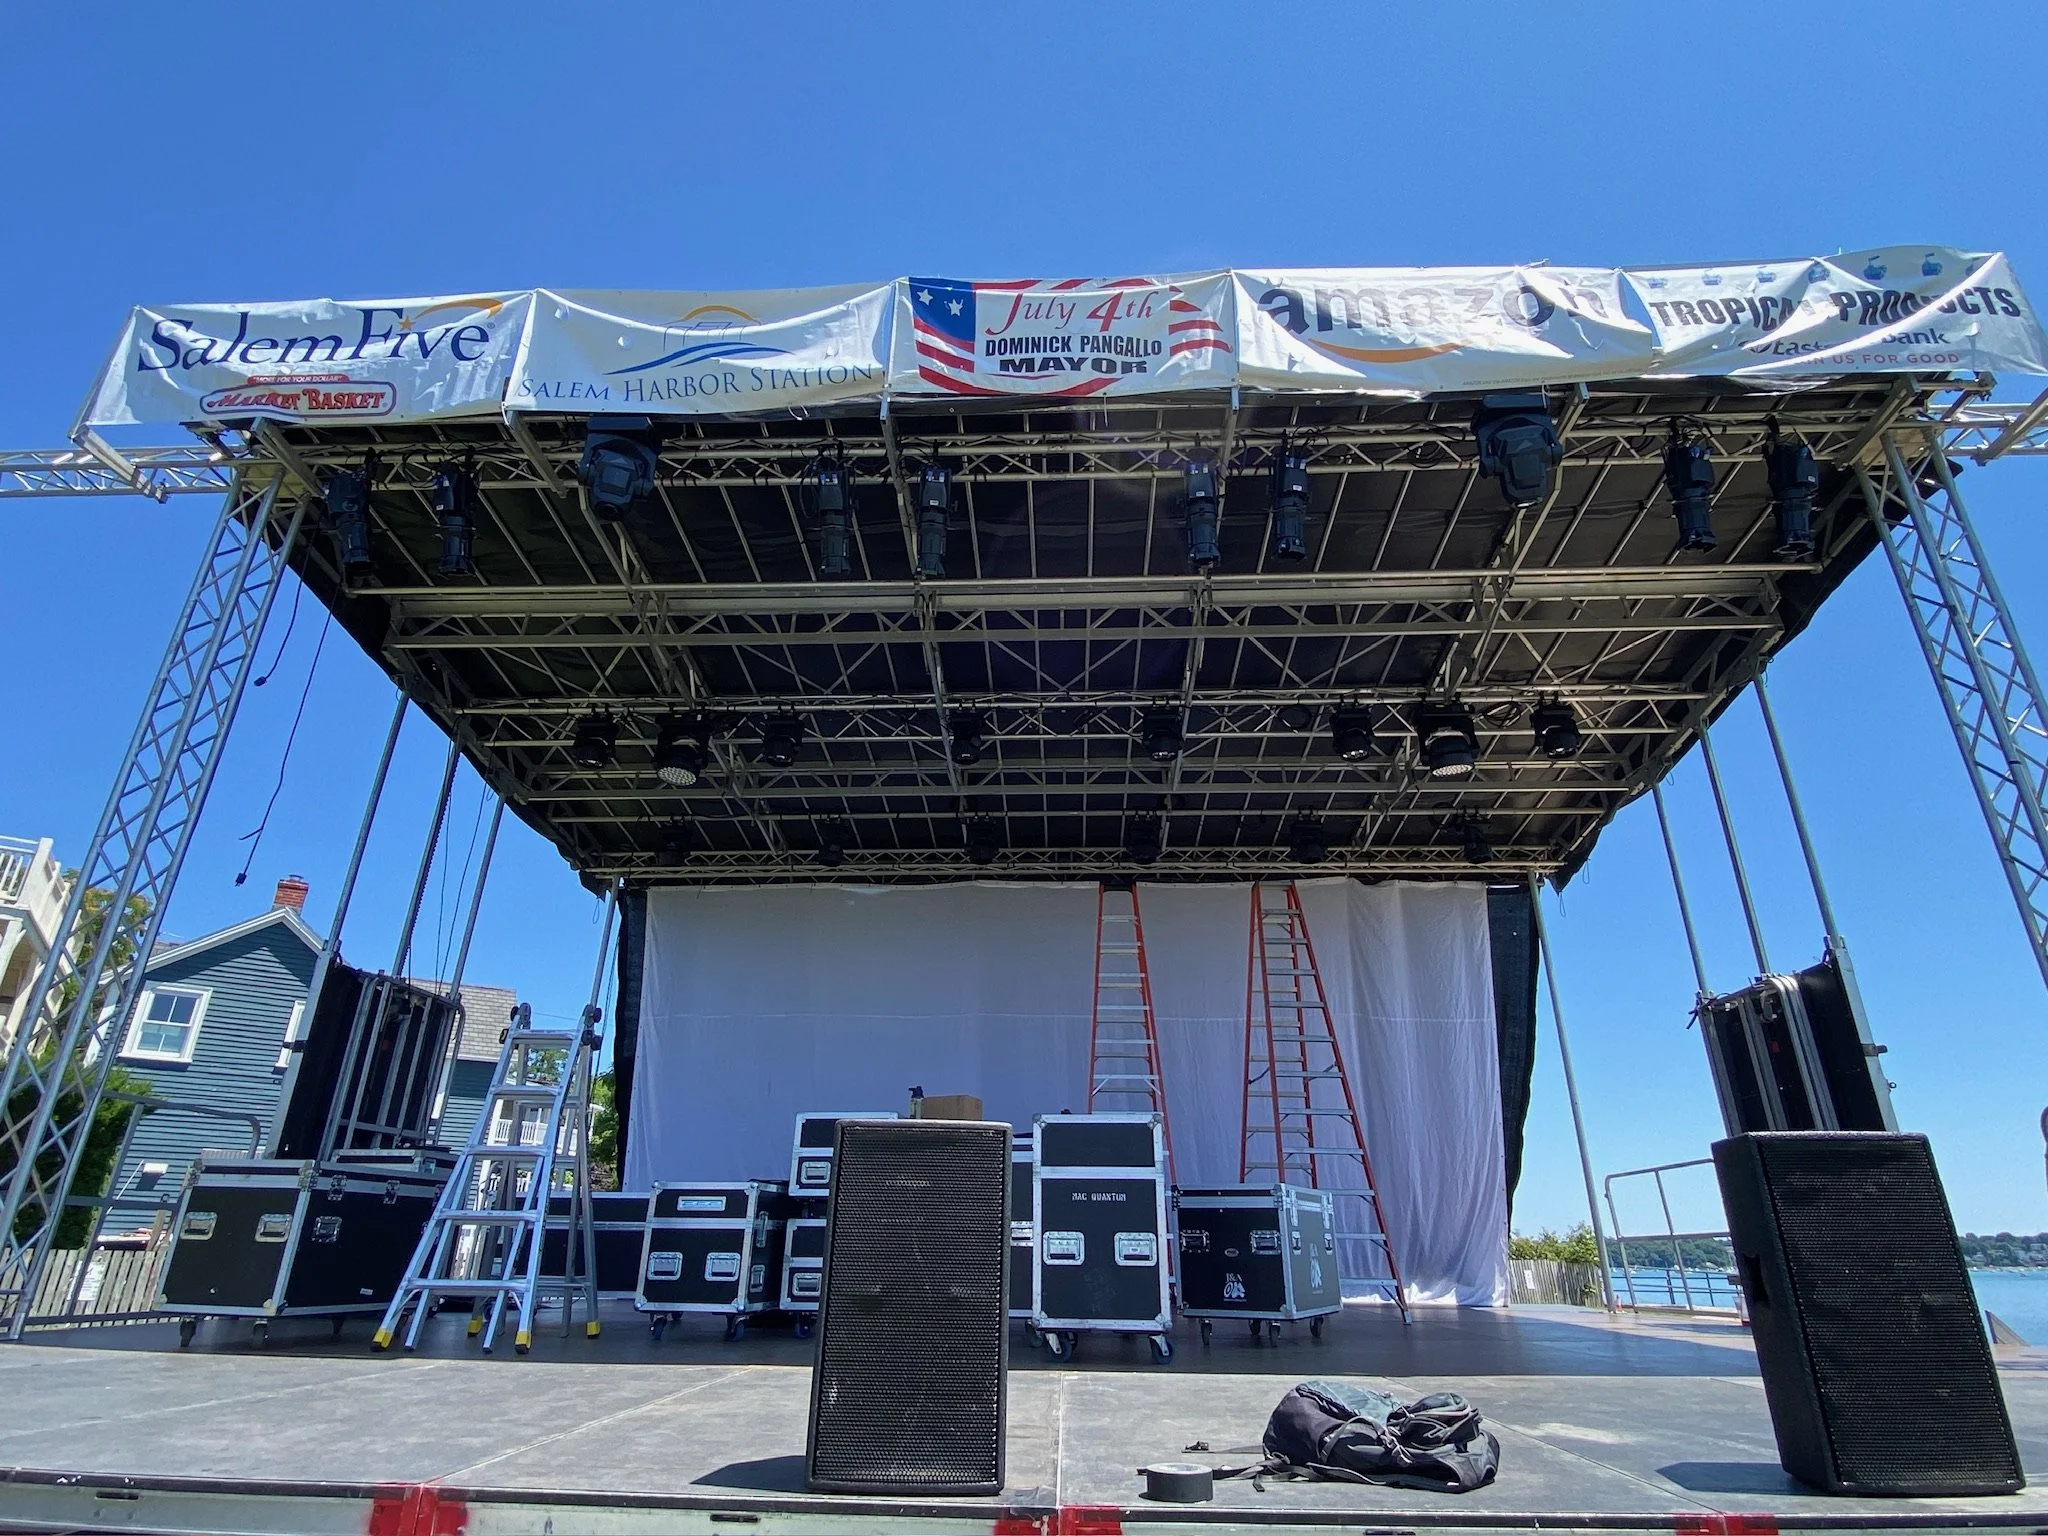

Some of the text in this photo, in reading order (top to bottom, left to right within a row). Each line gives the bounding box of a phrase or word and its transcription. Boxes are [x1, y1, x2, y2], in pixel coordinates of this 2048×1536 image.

[985, 290, 1159, 336] July 4th
[1258, 284, 1608, 334] amazon
[985, 334, 1162, 357] DOMINICK PANGALLO
[999, 356, 1148, 375] MAYOR
[1833, 354, 1856, 365] US
[1863, 353, 1899, 365] FOR
[1906, 352, 1960, 364] GOOD
[517, 363, 873, 403] SALEM HARBOR STATION
[207, 388, 387, 410] MARKET BASKET
[1071, 1192, 1127, 1202] MAC QUANTUM
